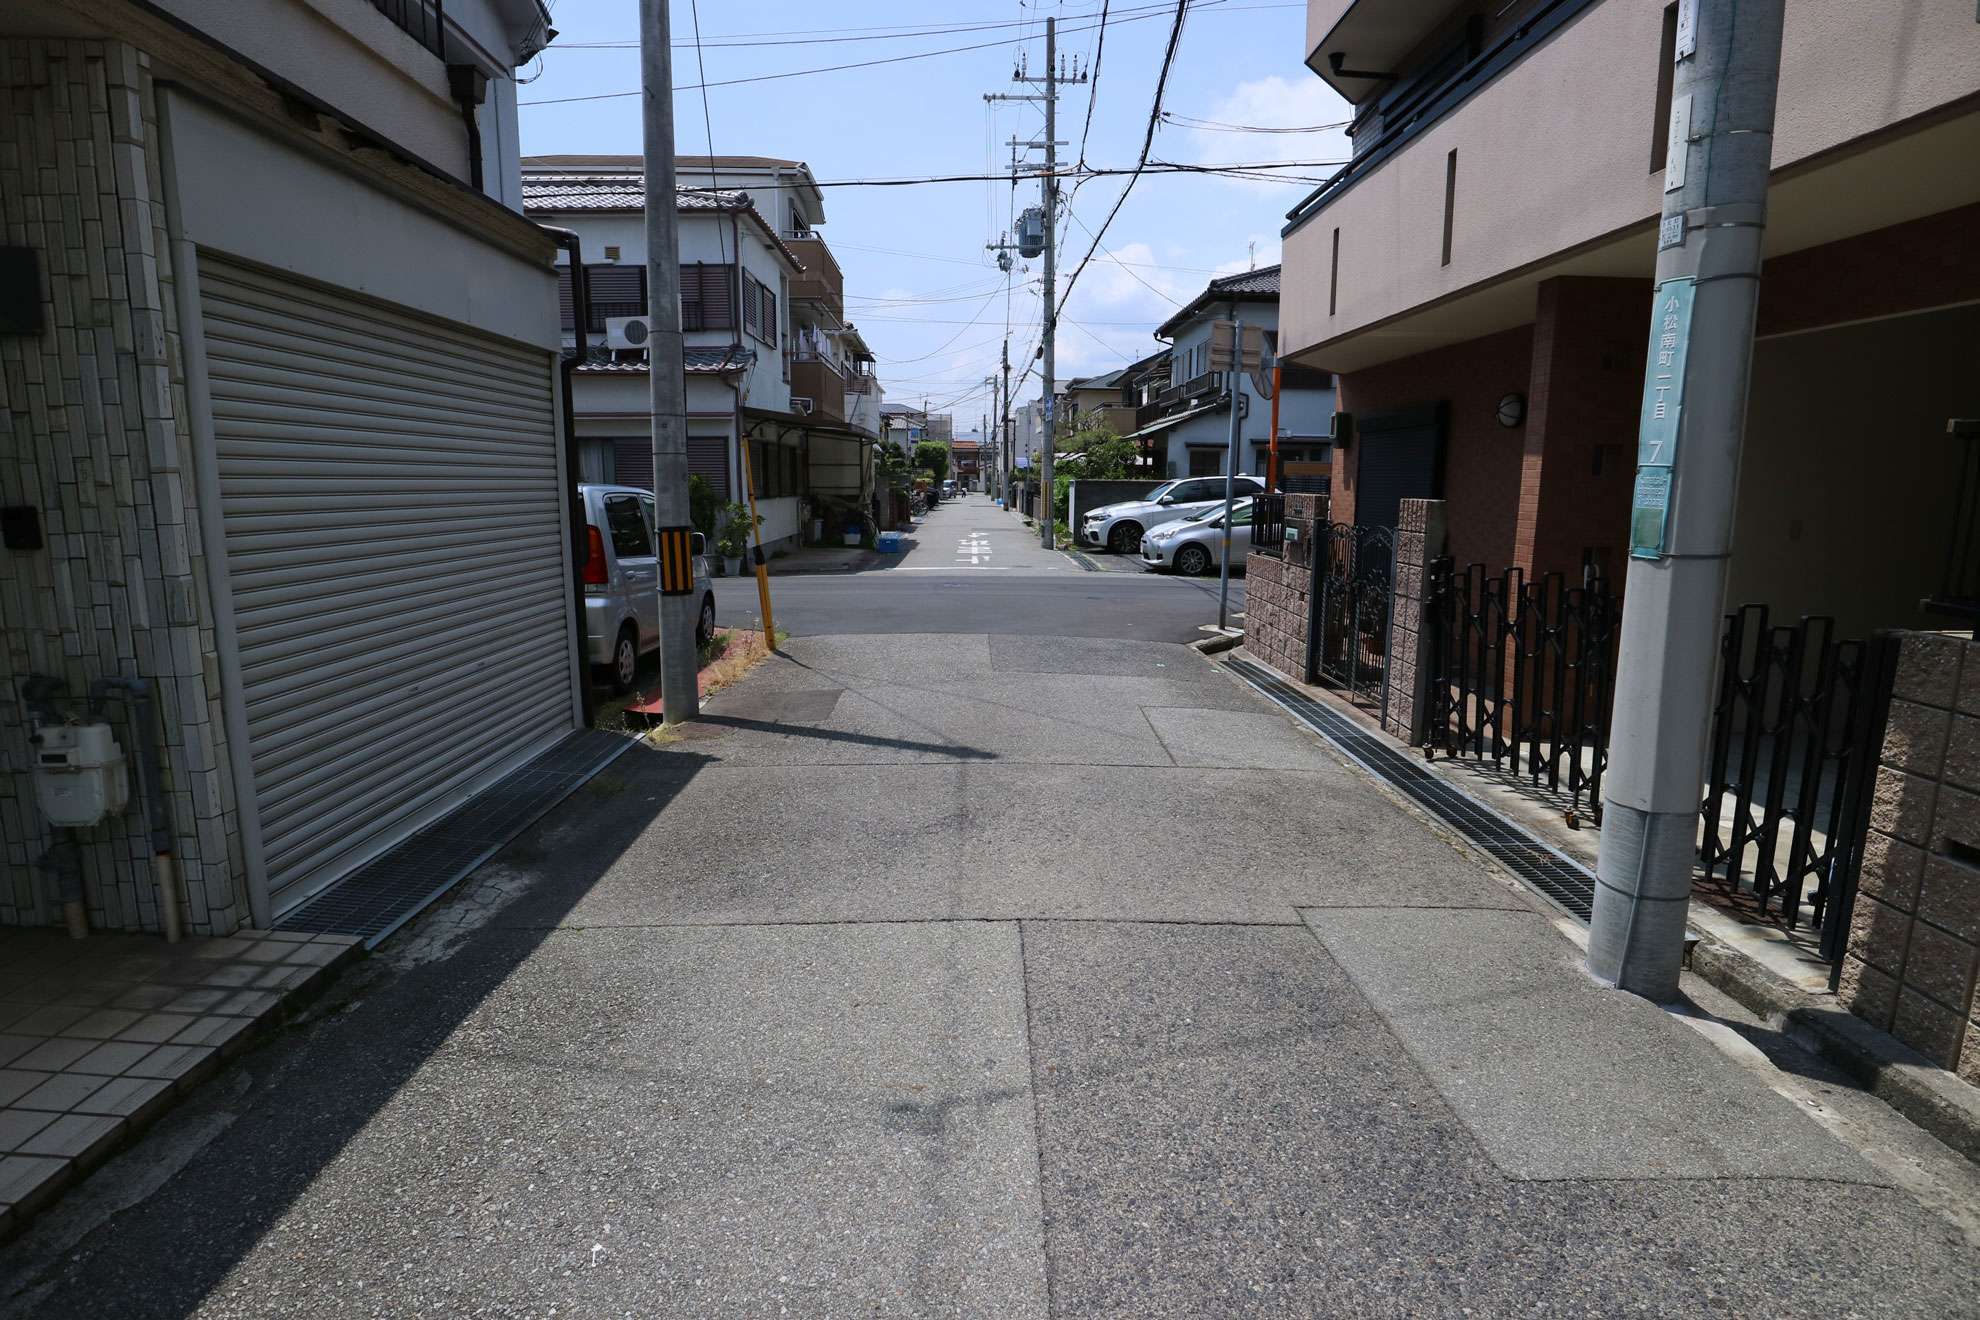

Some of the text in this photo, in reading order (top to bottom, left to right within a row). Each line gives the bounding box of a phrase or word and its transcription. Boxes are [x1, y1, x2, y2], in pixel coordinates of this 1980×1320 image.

[1654, 296, 1680, 420] 小松南町一丁目
[1648, 440, 1665, 464] 7
